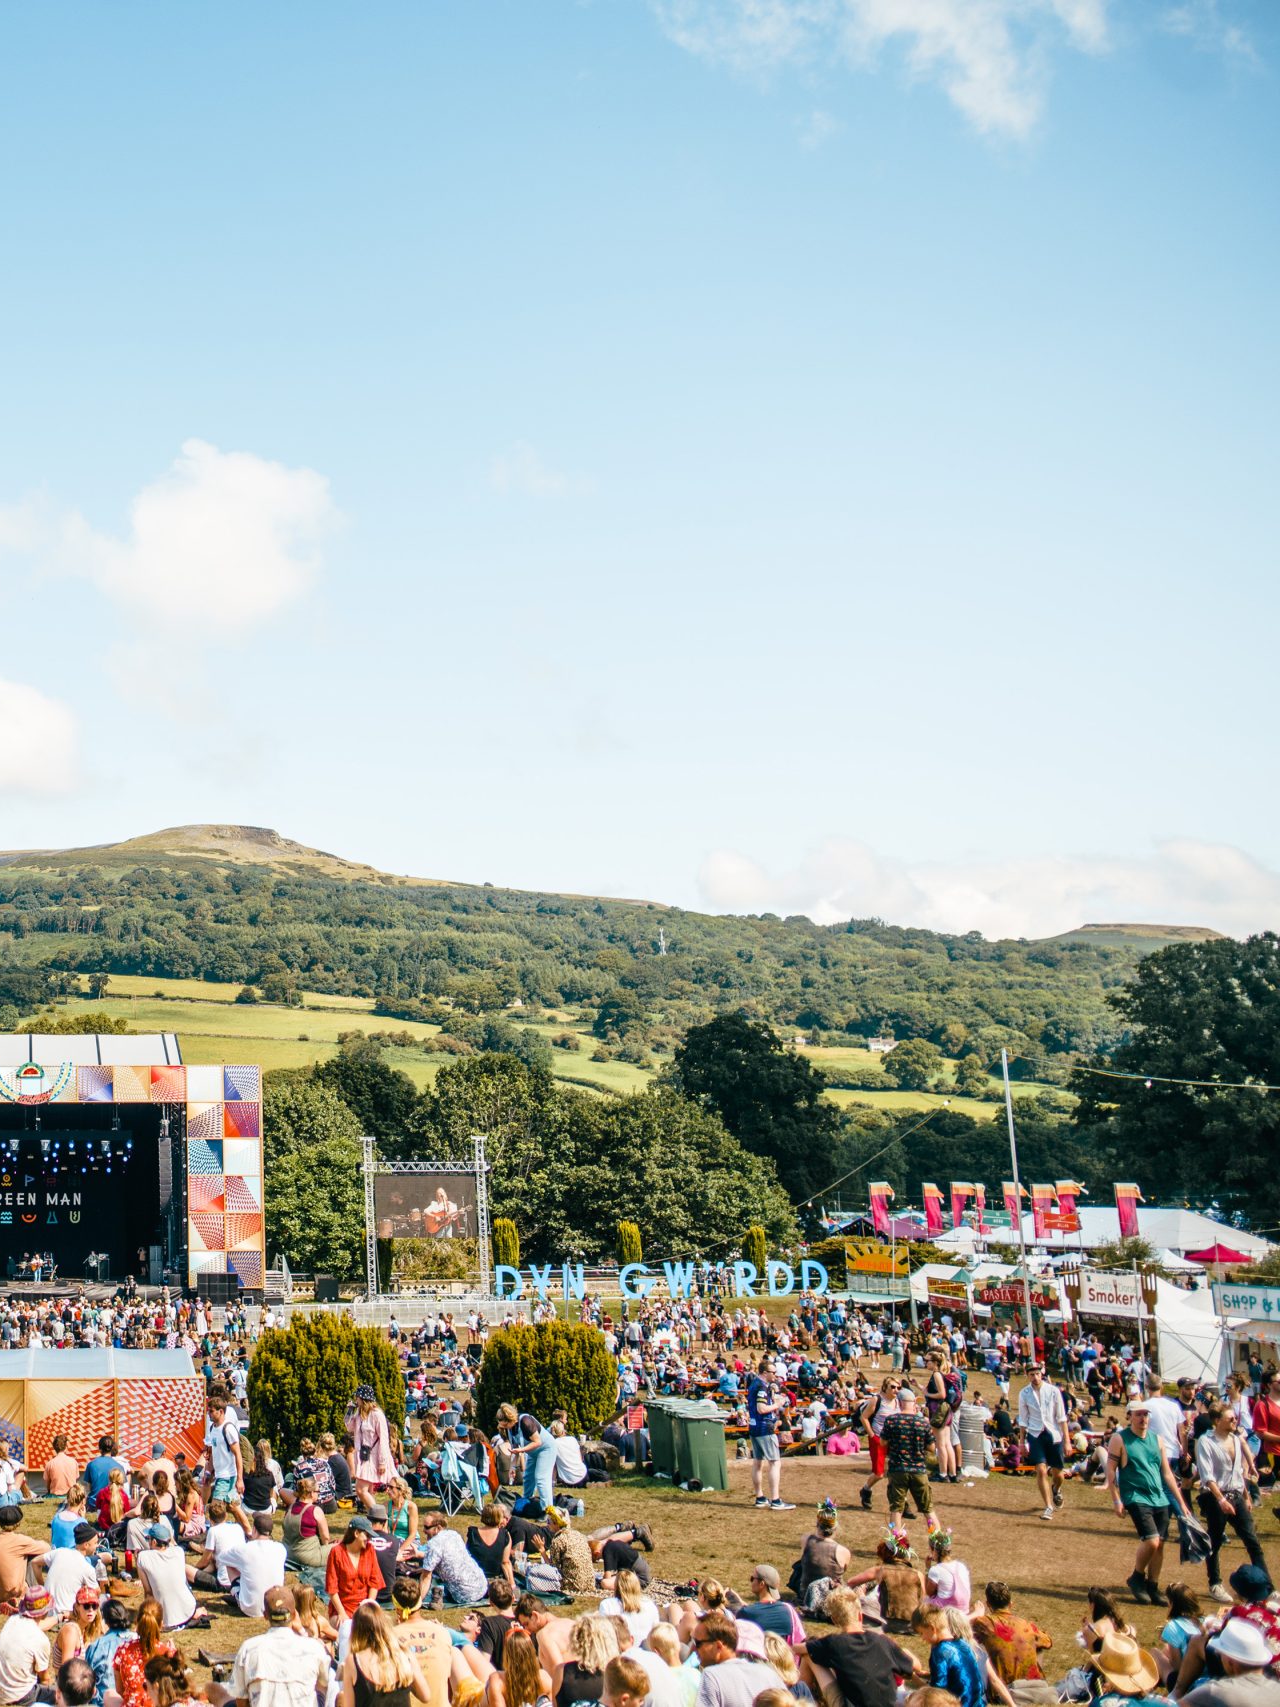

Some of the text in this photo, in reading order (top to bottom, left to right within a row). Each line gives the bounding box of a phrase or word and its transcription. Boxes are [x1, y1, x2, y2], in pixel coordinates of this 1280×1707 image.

[46, 1192, 81, 1206] MAN
[495, 1263, 585, 1301] DYN
[983, 1288, 1011, 1301] PASTA
[1016, 1289, 1045, 1305] PIZA
[1222, 1293, 1257, 1310] SHOP
